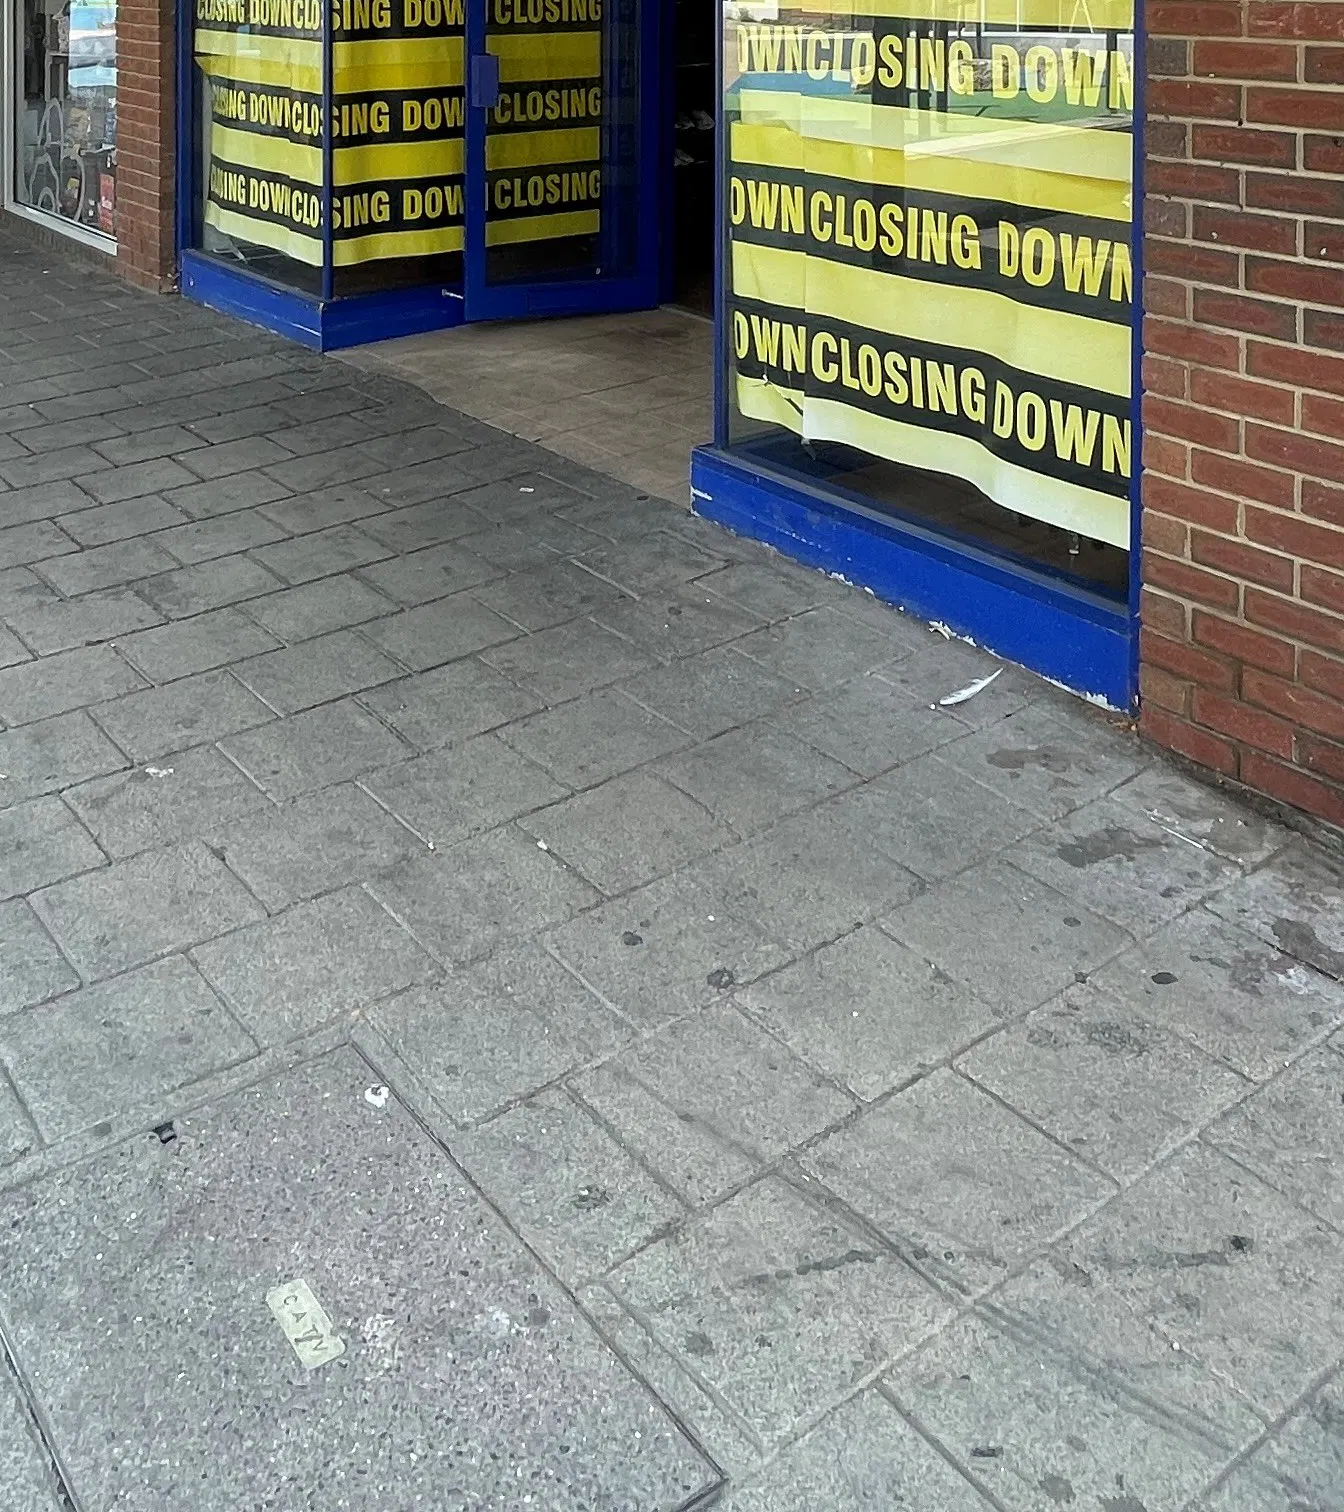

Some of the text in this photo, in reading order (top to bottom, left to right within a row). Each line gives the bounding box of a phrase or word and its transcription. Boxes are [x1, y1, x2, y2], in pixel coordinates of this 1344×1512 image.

[806, 30, 975, 95] CLOSING
[991, 44, 1134, 110] DOWN
[291, 99, 324, 137] CLO
[402, 96, 465, 132] DOW
[494, 86, 602, 124] CLOSING
[291, 189, 324, 229] CLO
[402, 184, 465, 221] DOW
[494, 169, 602, 210] CLOSING
[809, 190, 983, 271] CLOSING
[998, 220, 1133, 304] DOWN
[811, 331, 987, 425] CLOSING
[992, 380, 1132, 478] DOWN
